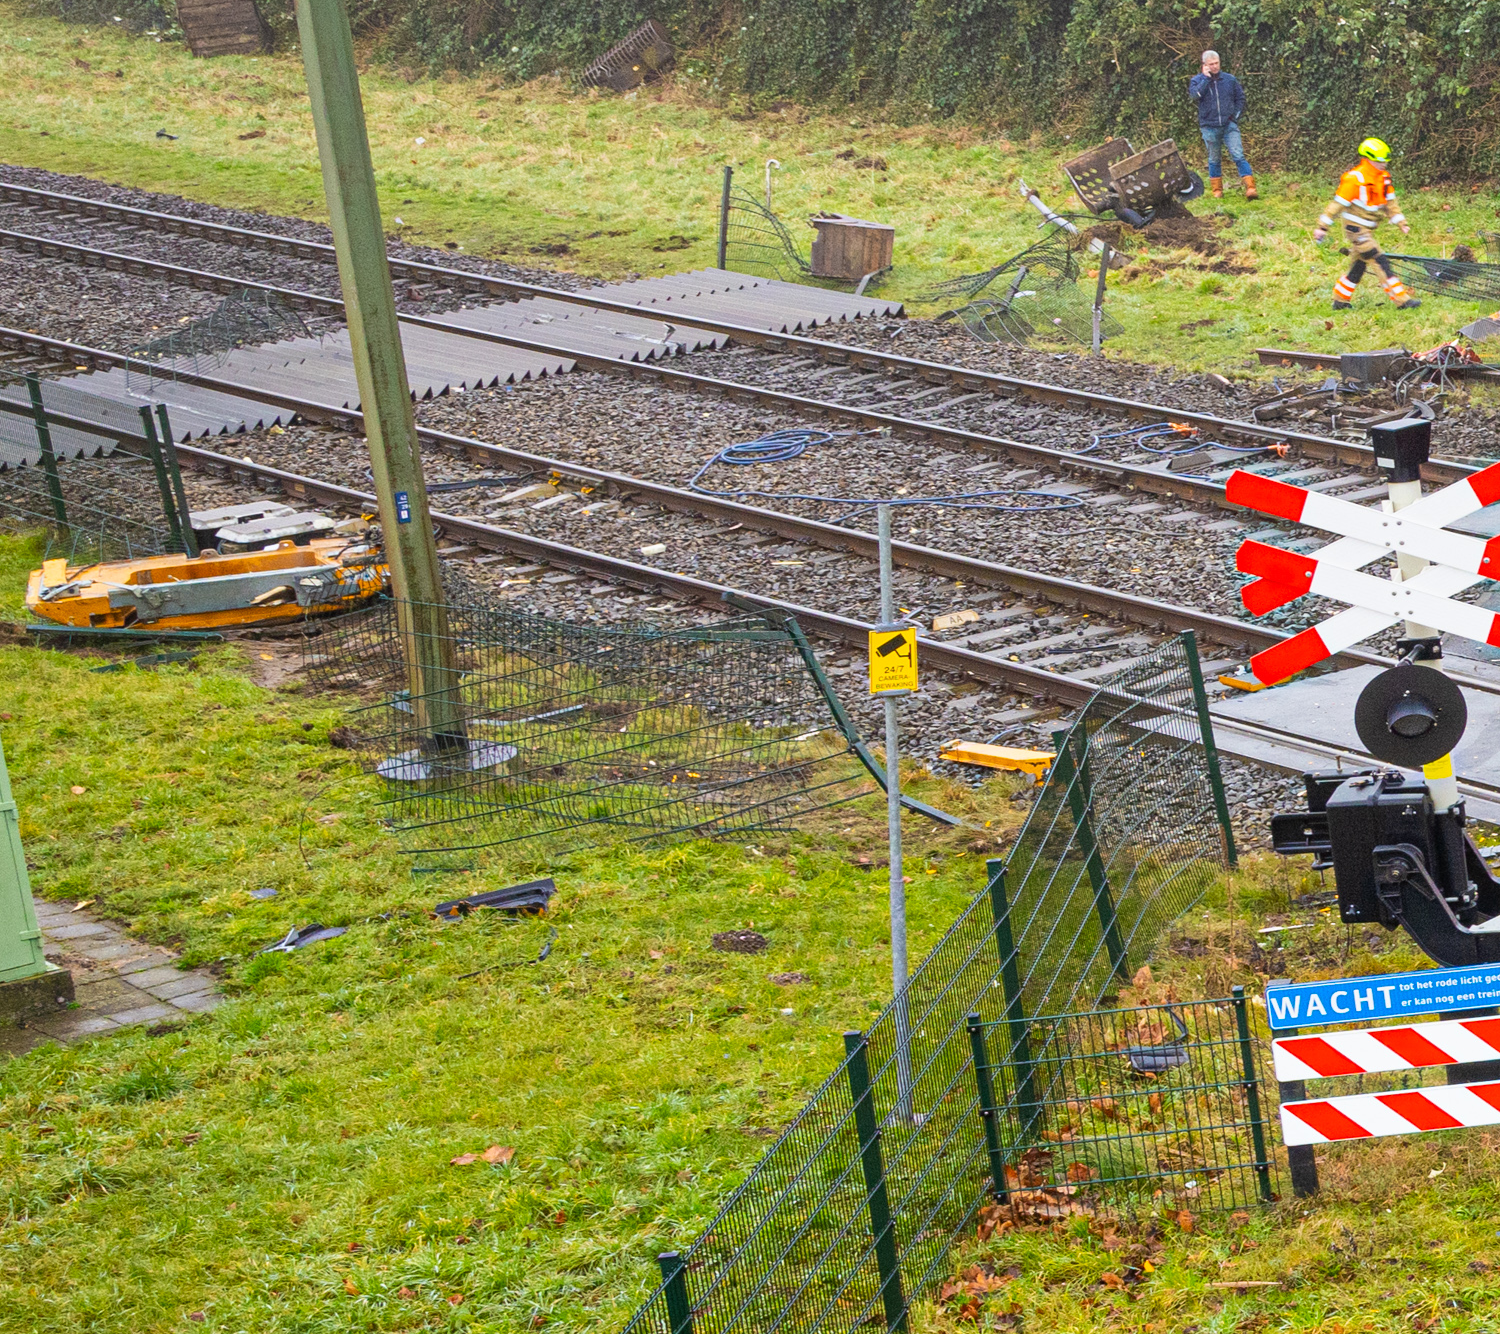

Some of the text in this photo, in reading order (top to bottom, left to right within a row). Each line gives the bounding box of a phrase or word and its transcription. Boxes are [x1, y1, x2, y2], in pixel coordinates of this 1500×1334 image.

[949, 615, 964, 625] AA
[884, 665, 905, 674] 24/7
[875, 680, 914, 689] BEWAKING
[1399, 982, 1415, 992] tot
[1417, 980, 1434, 990] het
[1436, 976, 1458, 988] rode
[1460, 974, 1483, 985] licht
[1270, 985, 1396, 1020] WACHT
[1401, 999, 1412, 1008] er
[1414, 995, 1433, 1006] kan
[1435, 994, 1455, 1006] nog
[1456, 992, 1475, 1002] een
